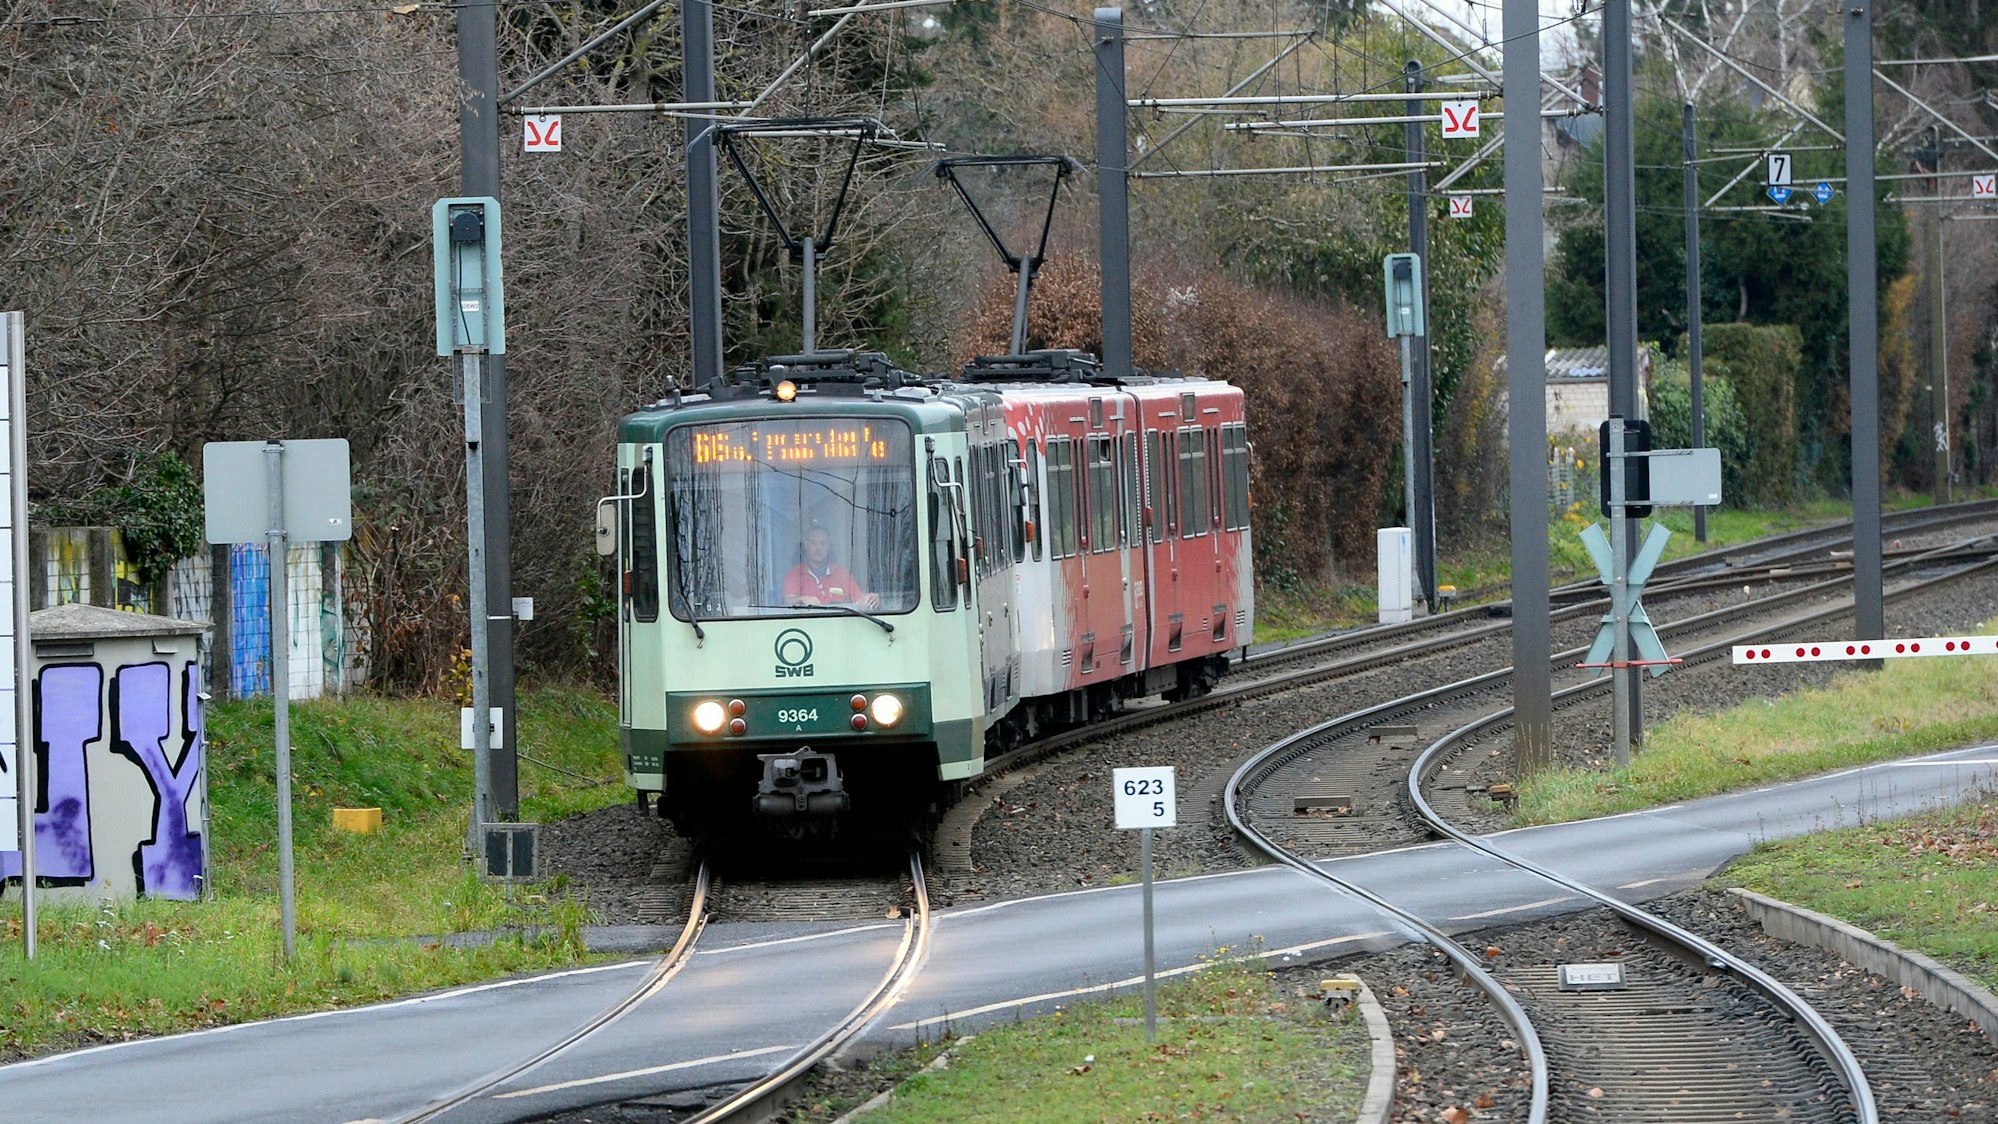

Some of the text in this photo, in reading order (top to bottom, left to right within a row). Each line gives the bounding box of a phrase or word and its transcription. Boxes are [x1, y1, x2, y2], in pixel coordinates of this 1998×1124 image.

[1774, 157, 1785, 182] 7
[775, 664, 814, 678] SWB
[778, 708, 818, 723] 9364
[795, 724, 802, 732] A
[1124, 779, 1163, 796] 623
[1153, 801, 1165, 817] 5
[1570, 973, 1616, 981] HET
